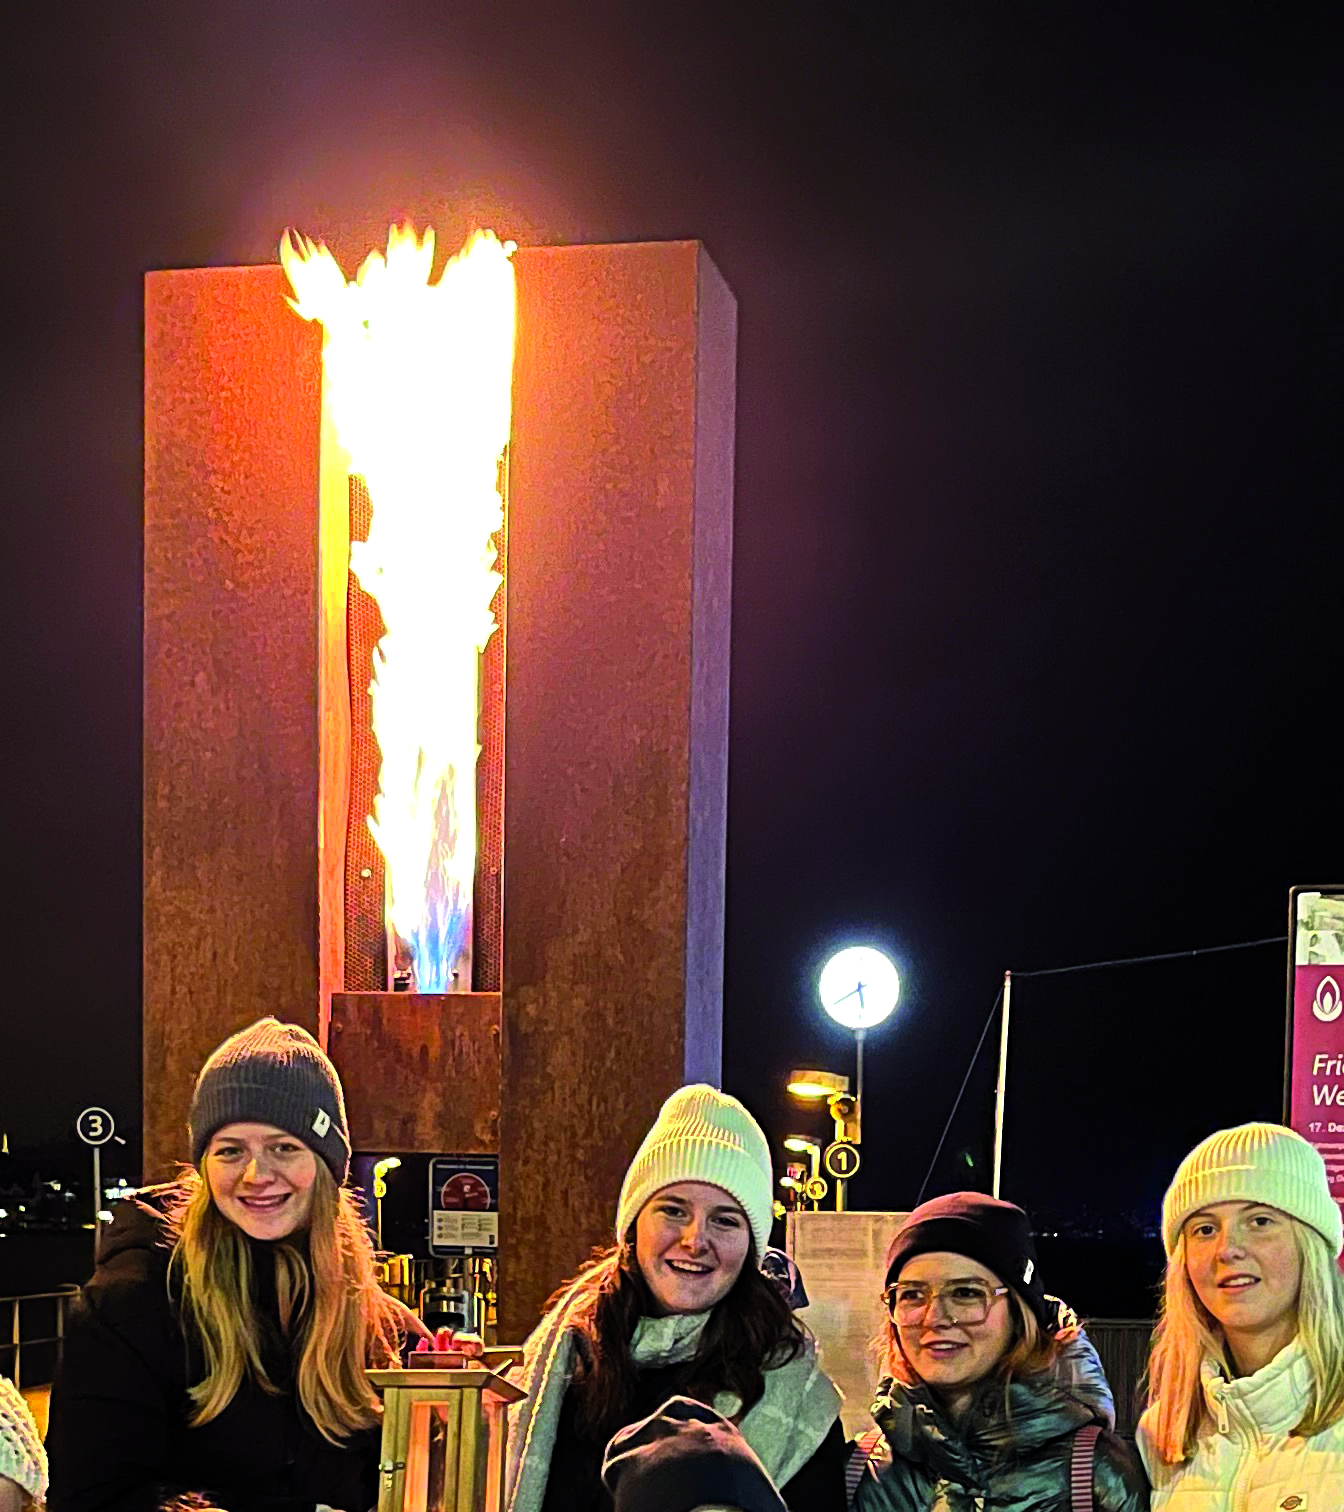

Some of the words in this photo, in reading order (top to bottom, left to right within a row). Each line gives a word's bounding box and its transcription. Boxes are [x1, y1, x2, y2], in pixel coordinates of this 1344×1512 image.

[88, 1115, 104, 1137] 3
[1308, 1122, 1326, 1133] 17.
[837, 1151, 848, 1171] 1
